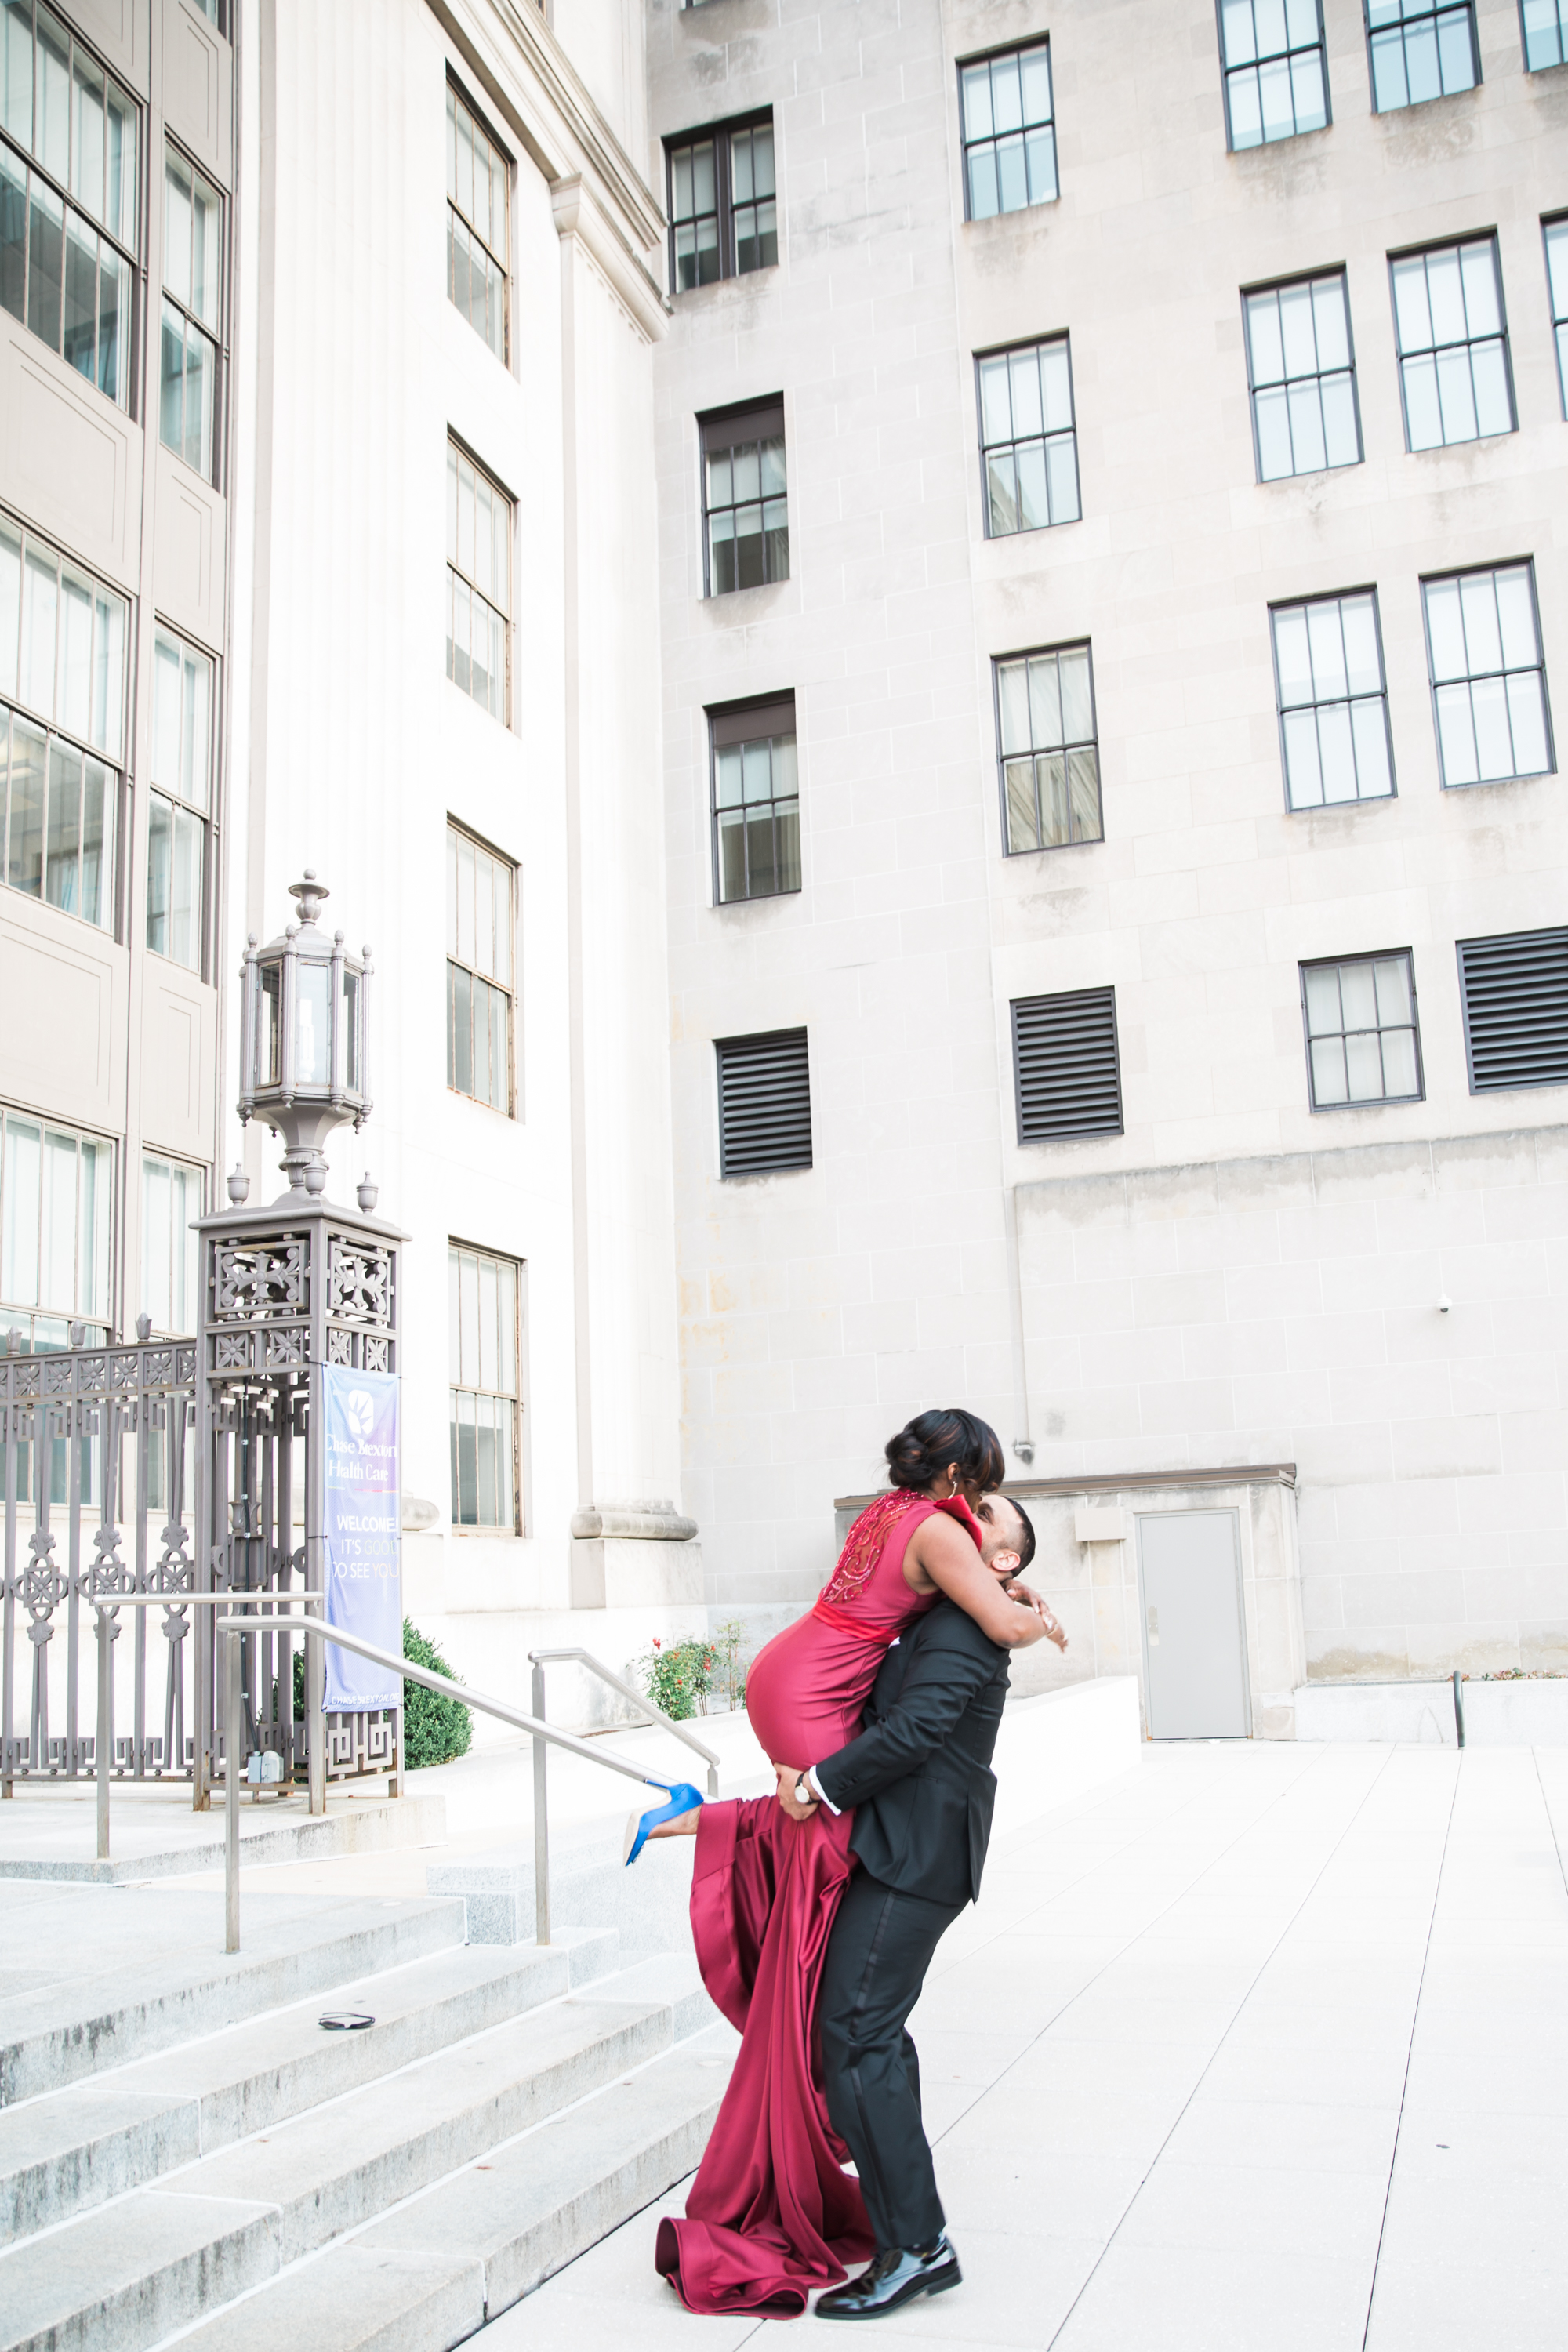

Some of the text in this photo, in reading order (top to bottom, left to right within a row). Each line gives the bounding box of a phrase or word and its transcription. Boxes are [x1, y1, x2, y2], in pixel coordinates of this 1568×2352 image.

[325, 1433, 398, 1457] Chase Brexton
[328, 1459, 389, 1481] Health Care
[336, 1515, 399, 1532] WELCOME!
[341, 1538, 399, 1555] IT'S GOOD
[350, 1562, 370, 1578] SEE
[372, 1563, 400, 1578] YOU
